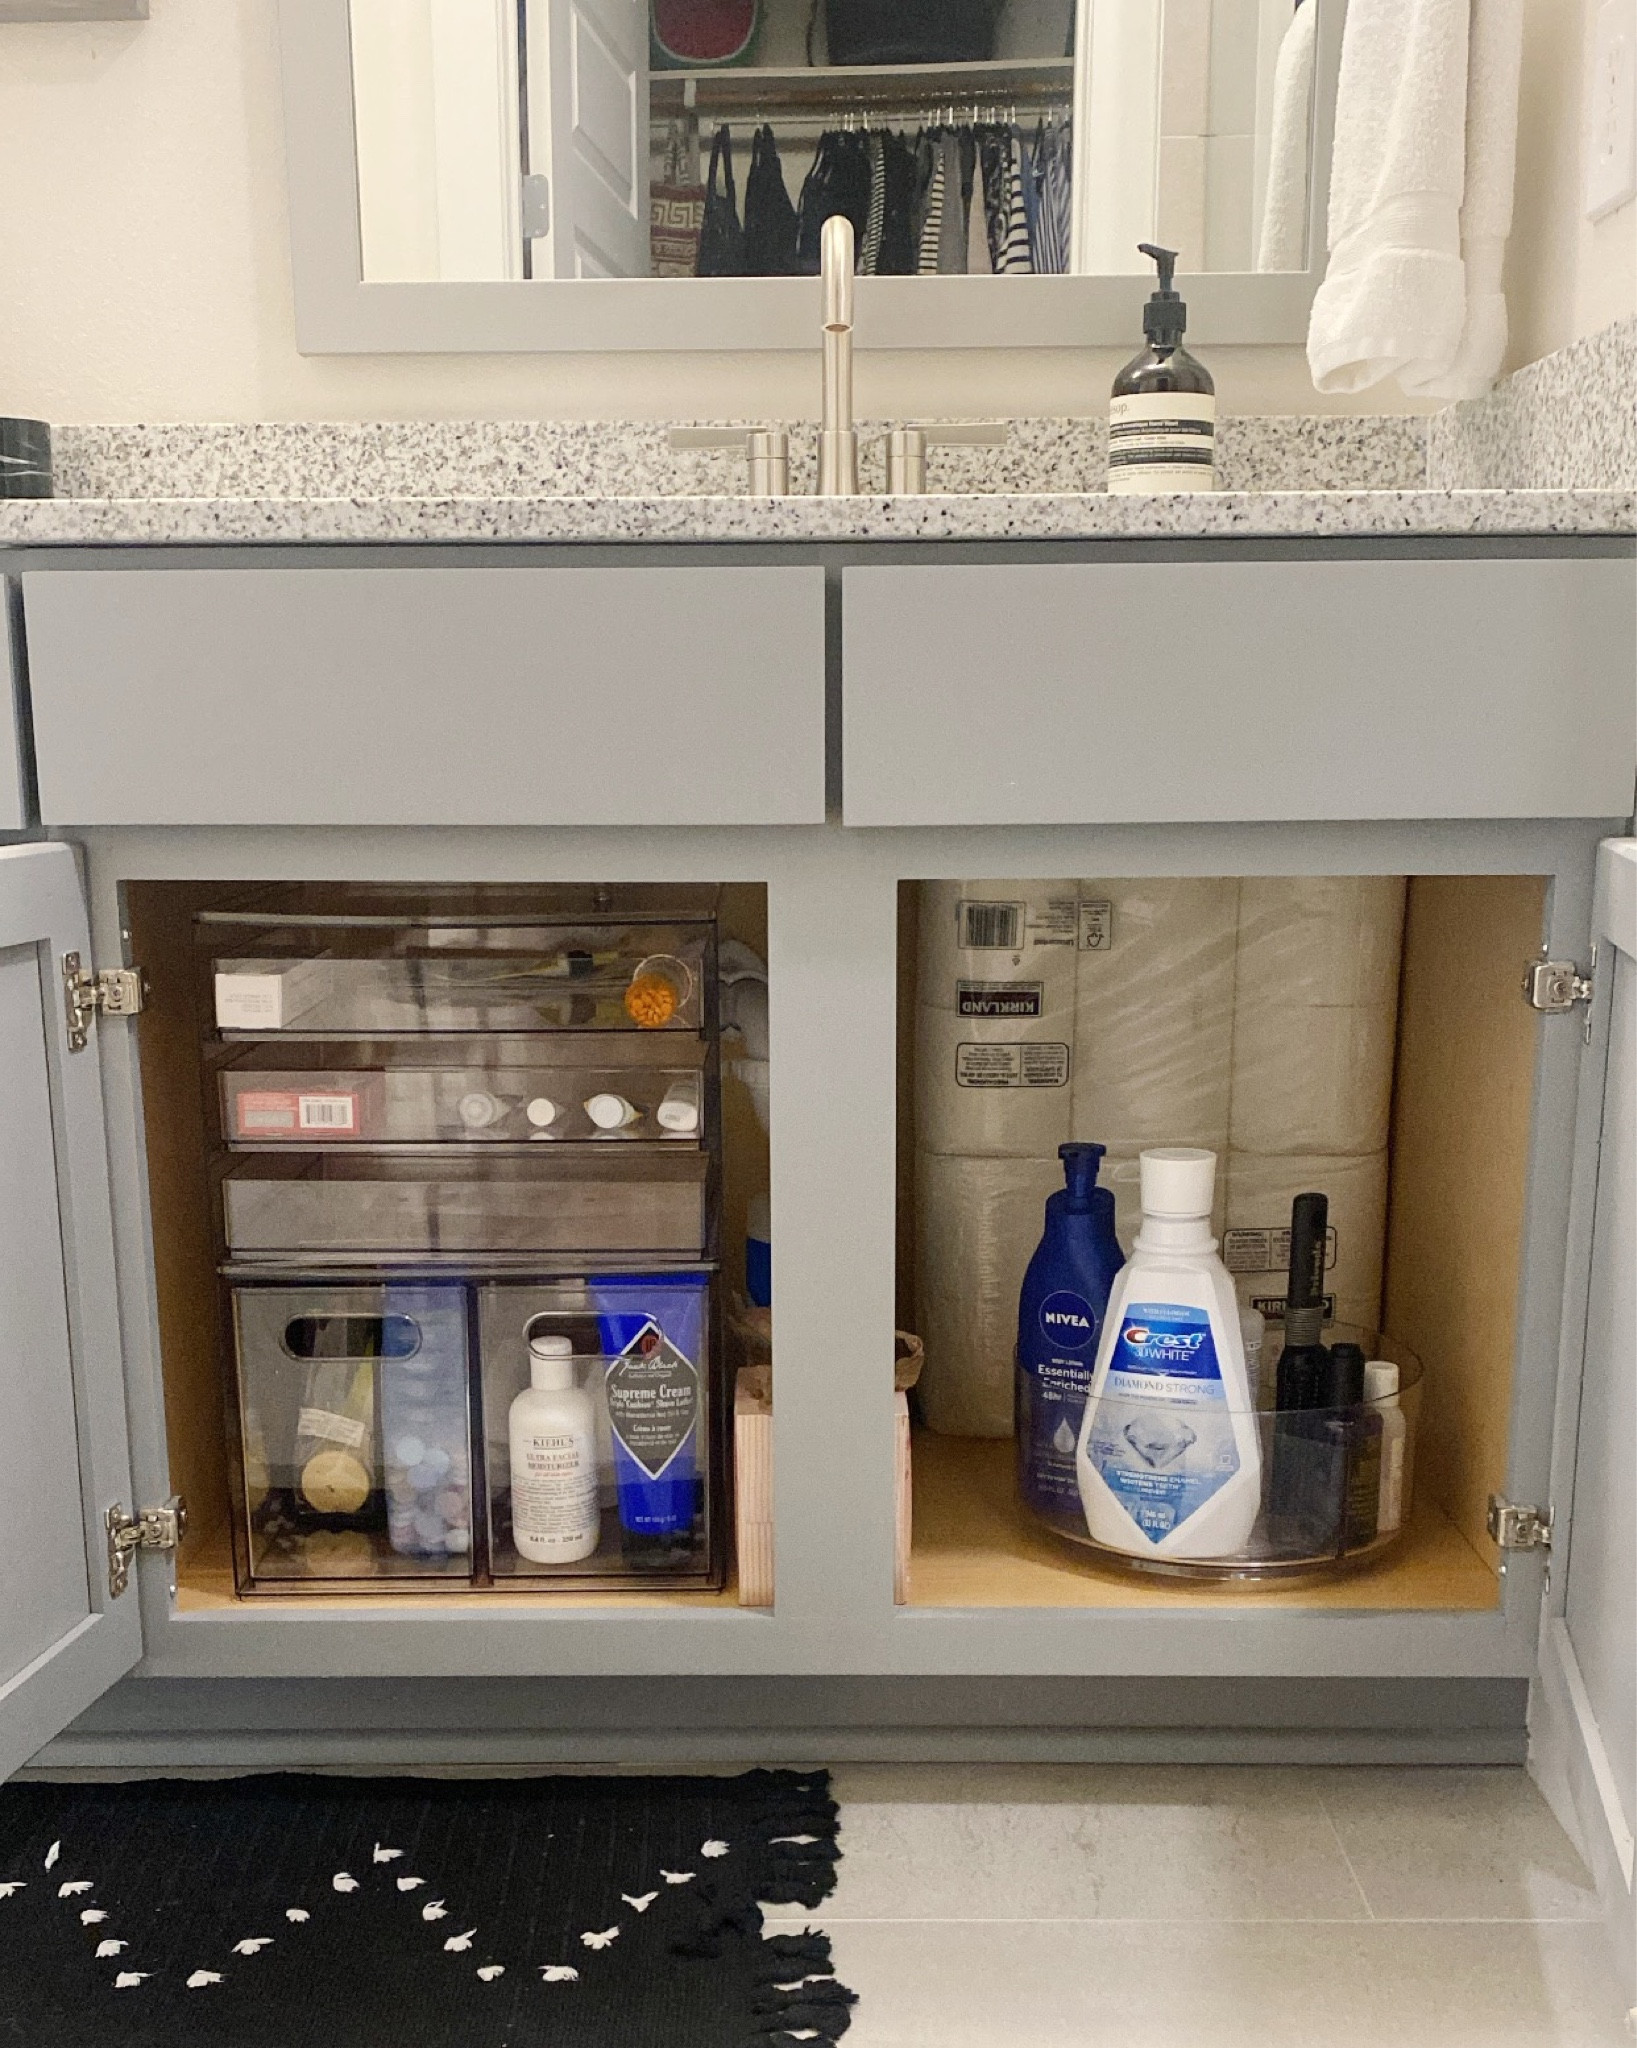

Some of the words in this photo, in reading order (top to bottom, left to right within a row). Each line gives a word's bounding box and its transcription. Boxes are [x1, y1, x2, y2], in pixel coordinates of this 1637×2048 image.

[962, 1001, 1034, 1013] KIRKLAND
[1045, 1312, 1090, 1328] NIVEA
[1124, 1325, 1203, 1349] Crest
[1149, 1349, 1190, 1361] WHITE
[611, 1384, 656, 1402] Supreme
[659, 1384, 691, 1398] Cream
[1042, 1377, 1091, 1393] Enriched
[1114, 1376, 1164, 1392] DIAMOND
[1165, 1382, 1215, 1395] STRONG
